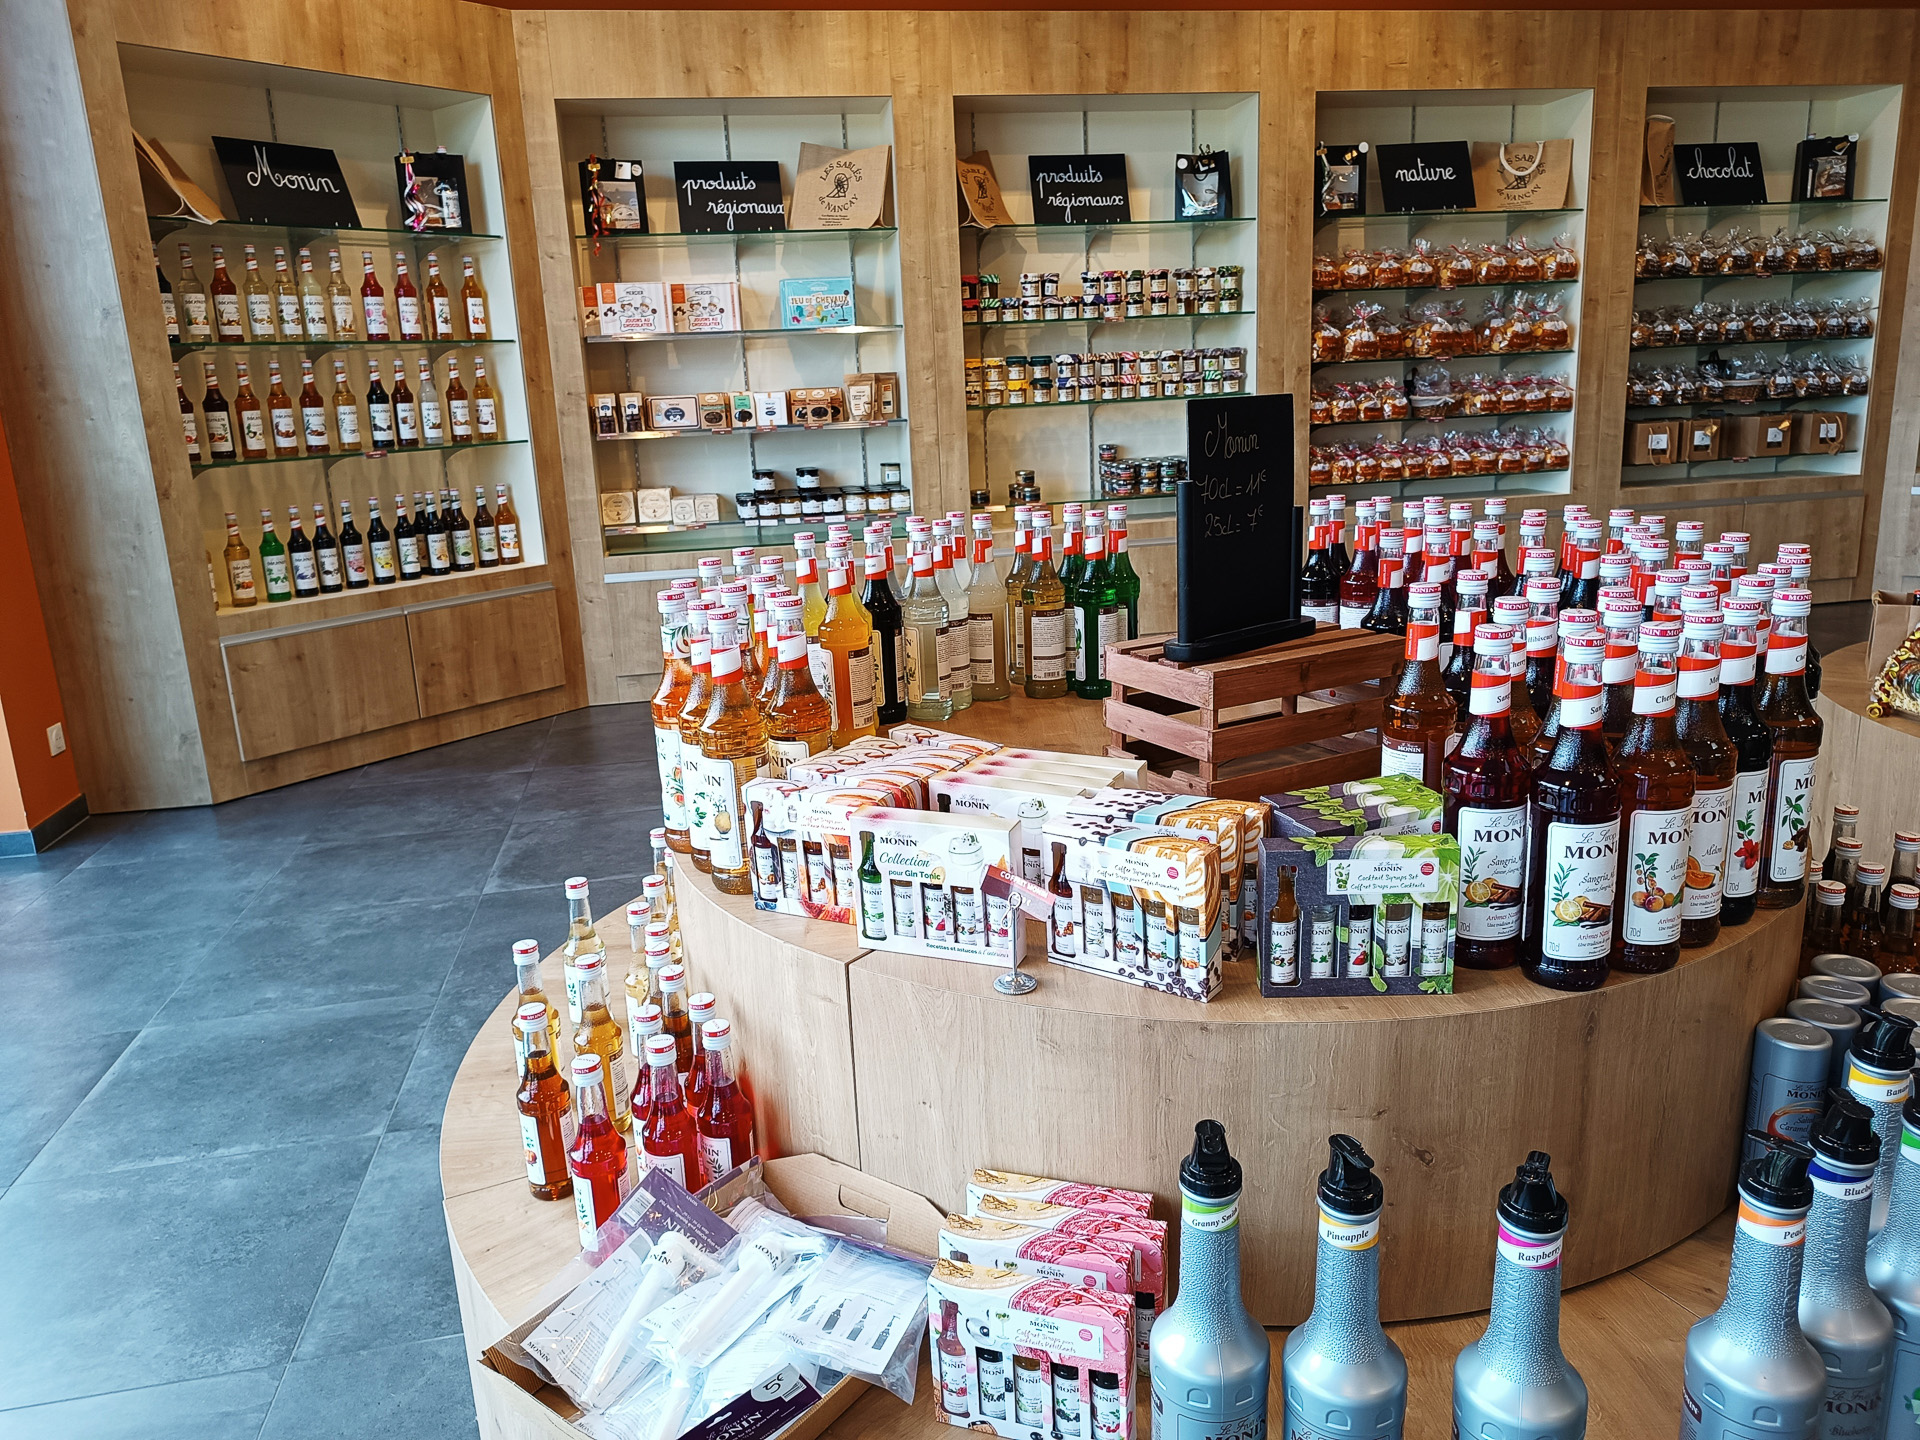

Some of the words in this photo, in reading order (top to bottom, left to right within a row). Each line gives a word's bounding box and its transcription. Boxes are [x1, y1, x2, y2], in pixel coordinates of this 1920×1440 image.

[246, 144, 340, 194] Monin
[1496, 157, 1513, 174] LS
[1686, 148, 1754, 180] chocolat
[820, 163, 834, 182] LES
[1395, 160, 1456, 184] nature
[1036, 164, 1103, 199] produits
[682, 172, 756, 206] produits
[1047, 187, 1124, 222] régionaux
[706, 197, 784, 231] régionaux
[1204, 412, 1260, 459] Monin
[1609, 604, 1640, 612] MONIN
[1729, 602, 1759, 610] MONIN
[1510, 660, 1527, 670] herry
[1398, 745, 1422, 753] MONIN
[956, 800, 990, 811] MONIN
[1484, 817, 1500, 828] Le
[880, 836, 918, 847] MONIN
[1576, 832, 1592, 844] Le
[880, 852, 930, 868] Collection
[1125, 858, 1149, 868] MONIN
[904, 869, 918, 878] Gin
[920, 870, 941, 880] Tonic
[1578, 874, 1609, 886] Sangria
[1026, 882, 1048, 898] MONIN
[926, 942, 949, 951] Recettes
[1192, 1218, 1220, 1228] Granny
[1326, 1228, 1370, 1244] Pineapple
[1036, 1268, 1064, 1278] MONIN
[1030, 1320, 1059, 1331] MONIN
[526, 1340, 551, 1363] MONIN
